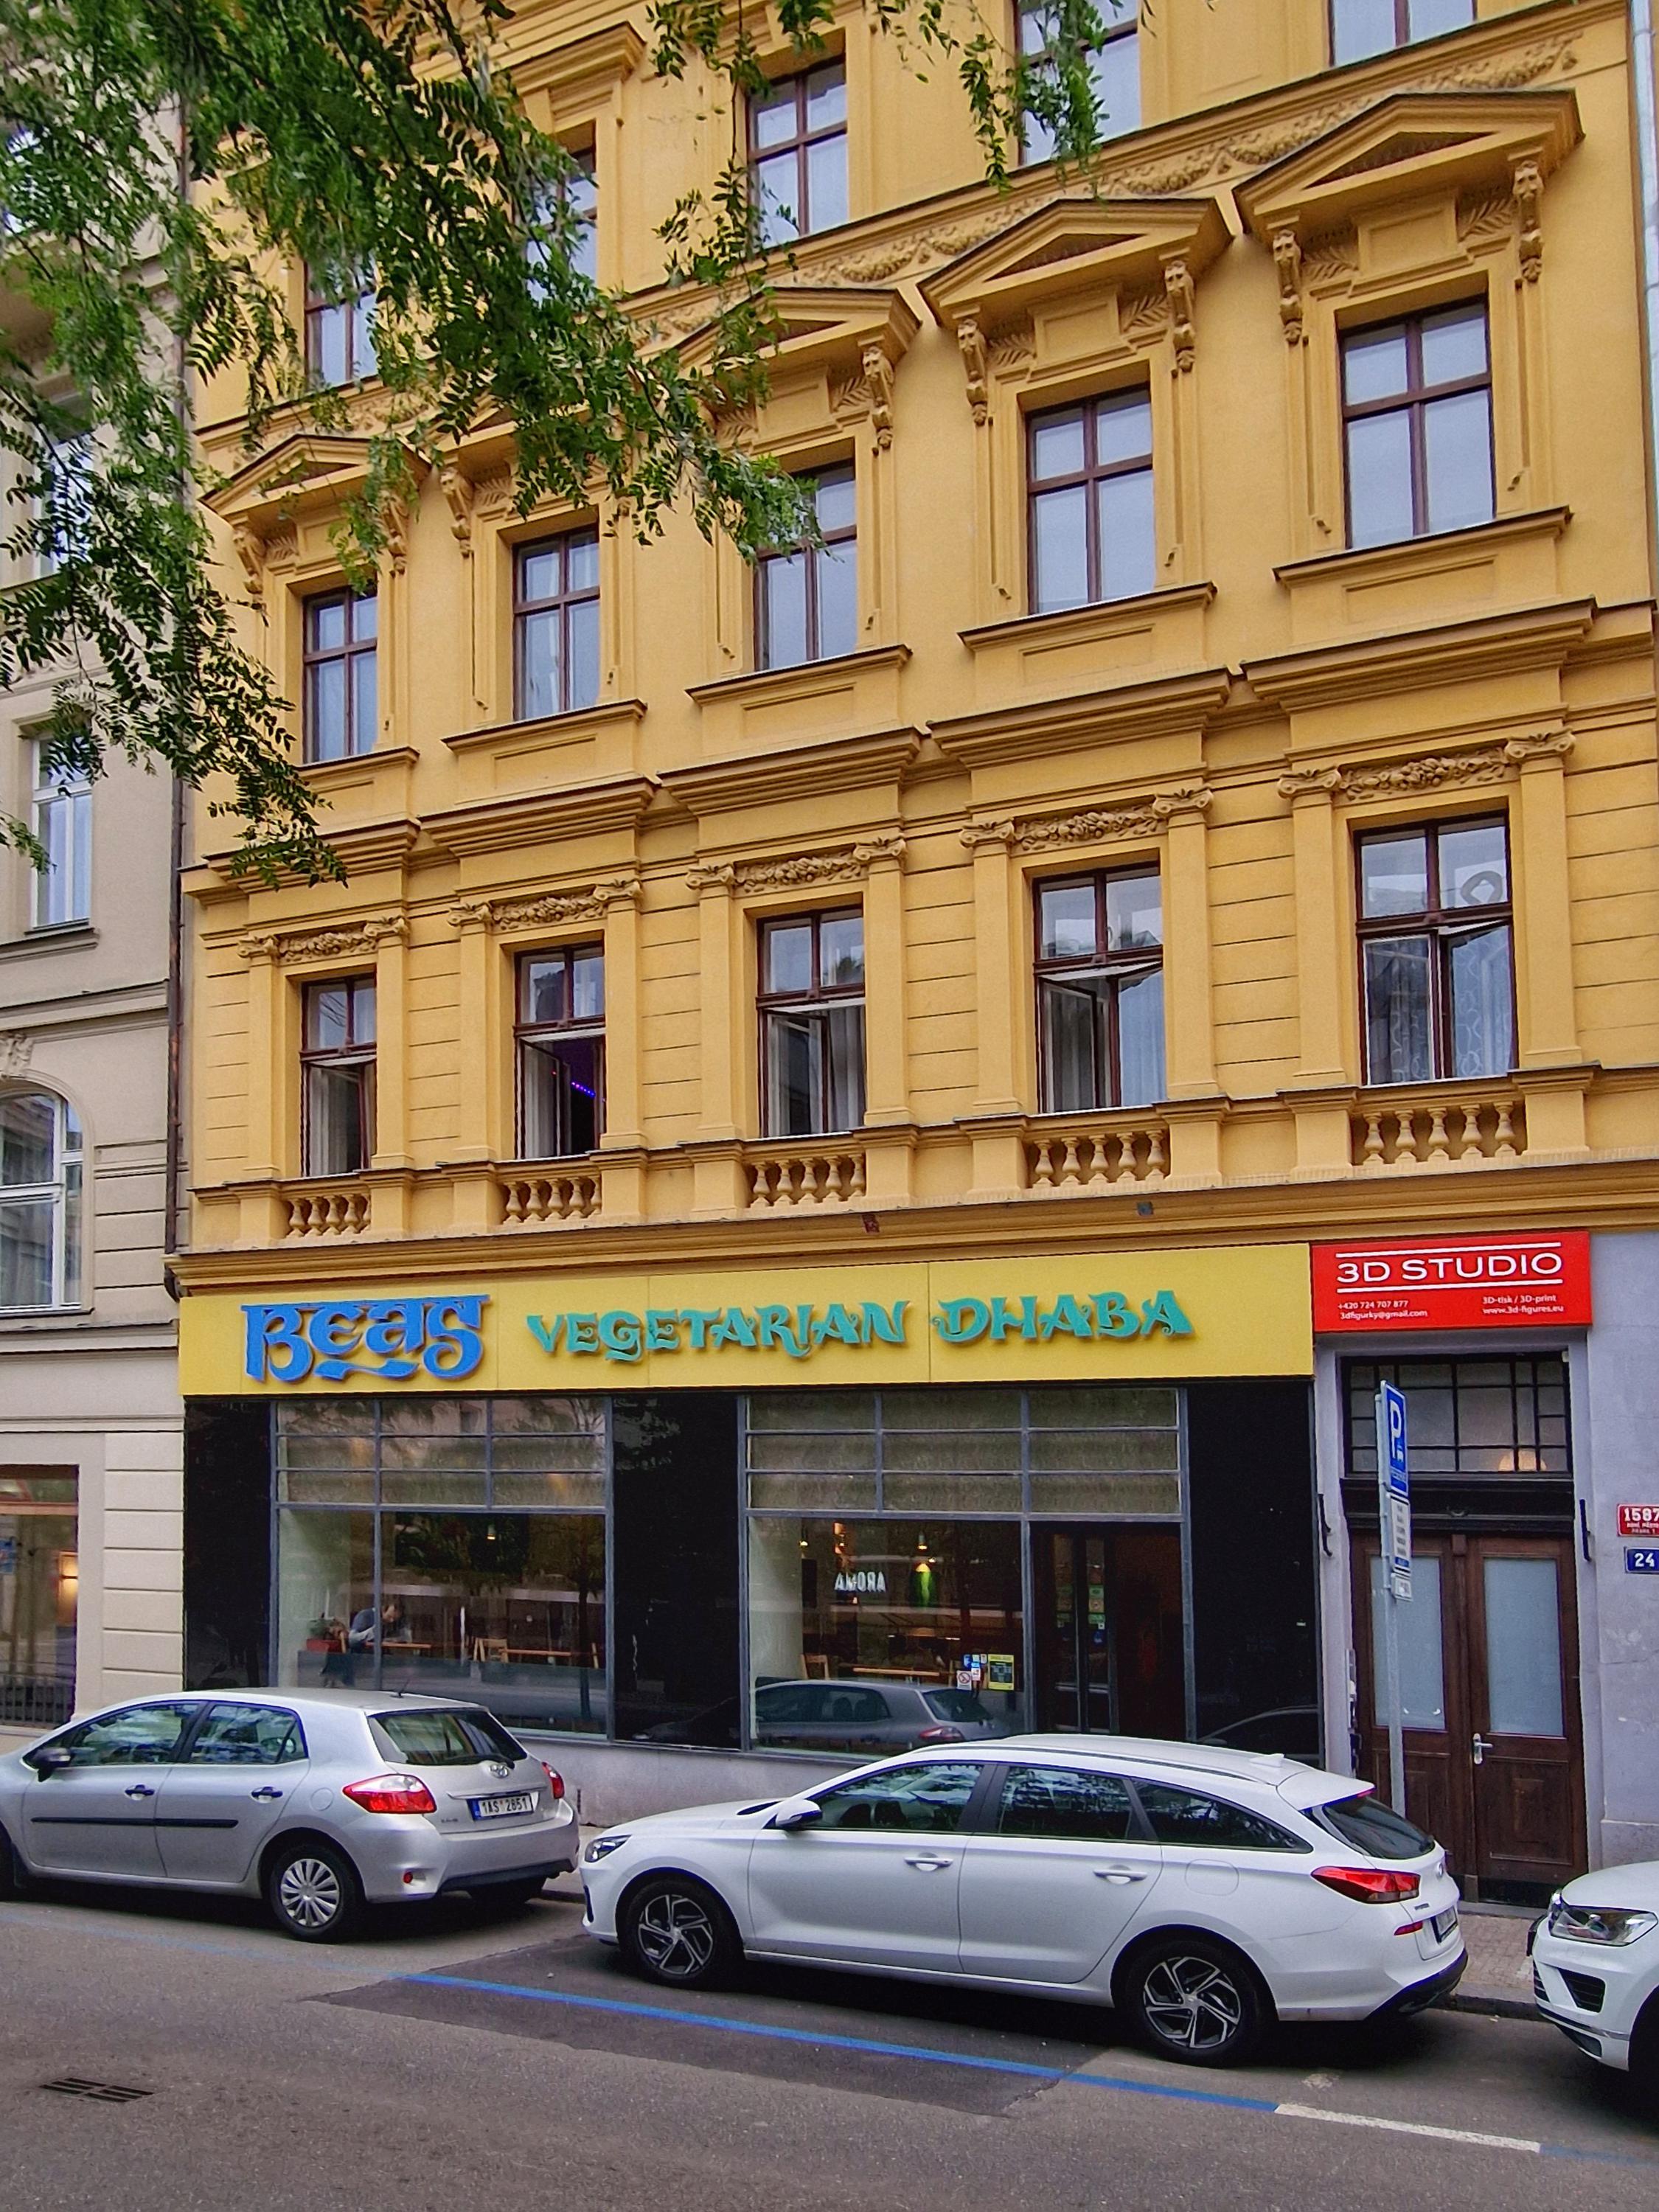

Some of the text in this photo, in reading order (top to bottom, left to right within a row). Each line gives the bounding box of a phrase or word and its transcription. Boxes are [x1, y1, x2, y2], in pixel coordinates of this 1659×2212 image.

[1337, 1252, 1562, 1283] 3D STUDIO
[1338, 1300, 1409, 1310] +420 724 707 877
[1520, 1294, 1557, 1304] 3D-print
[526, 1289, 1194, 1362] VEGETARIAN DHABA
[1389, 1399, 1402, 1459] P
[1624, 1507, 1659, 1522] 1587
[1634, 1552, 1655, 1568] 24
[481, 1800, 500, 1814] 1AS
